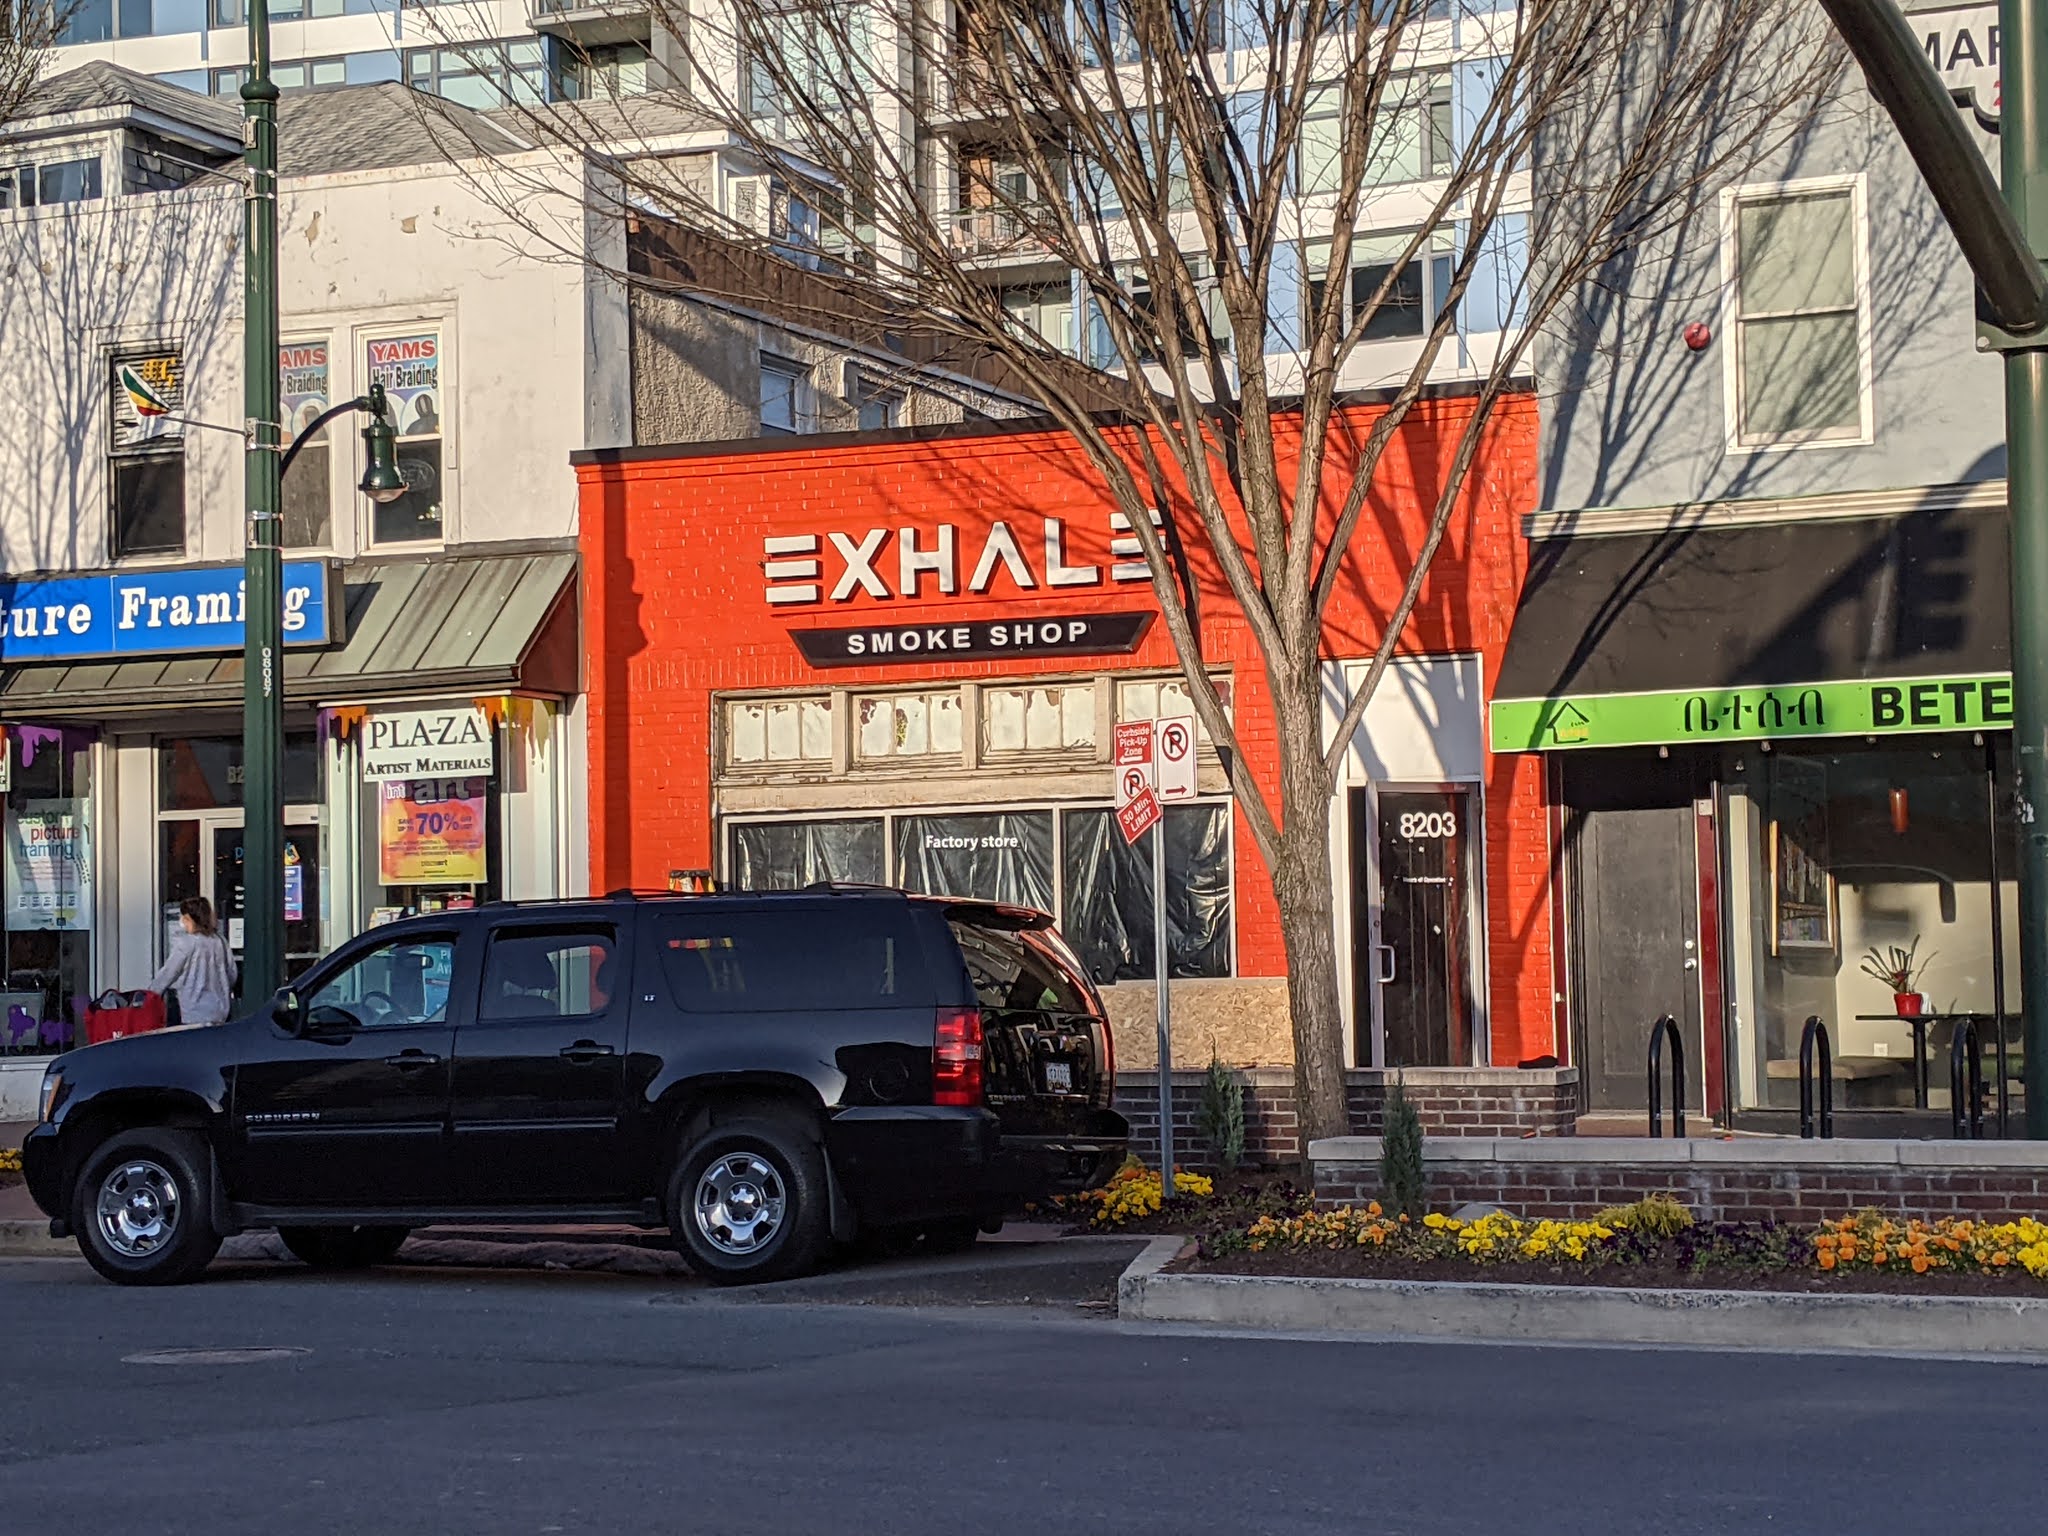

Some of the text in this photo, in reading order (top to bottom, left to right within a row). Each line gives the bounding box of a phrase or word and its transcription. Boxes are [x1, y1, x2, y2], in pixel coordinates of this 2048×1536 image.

[373, 340, 436, 363] YAMS
[286, 371, 328, 395] Braiding
[373, 363, 438, 389] Hair Braiding
[763, 508, 1168, 604] EXHALE
[118, 580, 310, 631] Framig
[847, 621, 1088, 655] SMOKE SHOP
[1684, 689, 1825, 733] ቤተሰብ
[1871, 680, 2013, 727] BETE
[368, 716, 485, 750] PLA-ZA
[1117, 726, 1150, 738] Curbside
[1119, 736, 1148, 747] Pick-Up
[1124, 747, 1143, 756] Zone
[365, 757, 491, 776] ARTIST MATERIALS
[413, 777, 471, 805] art
[415, 812, 460, 835] 70%
[1123, 810, 1134, 825] 30
[1130, 806, 1152, 832] LIMIT
[1400, 811, 1457, 838] 8203
[30, 824, 80, 844] picture
[925, 834, 1019, 852] Factory store
[20, 841, 74, 860] framing
